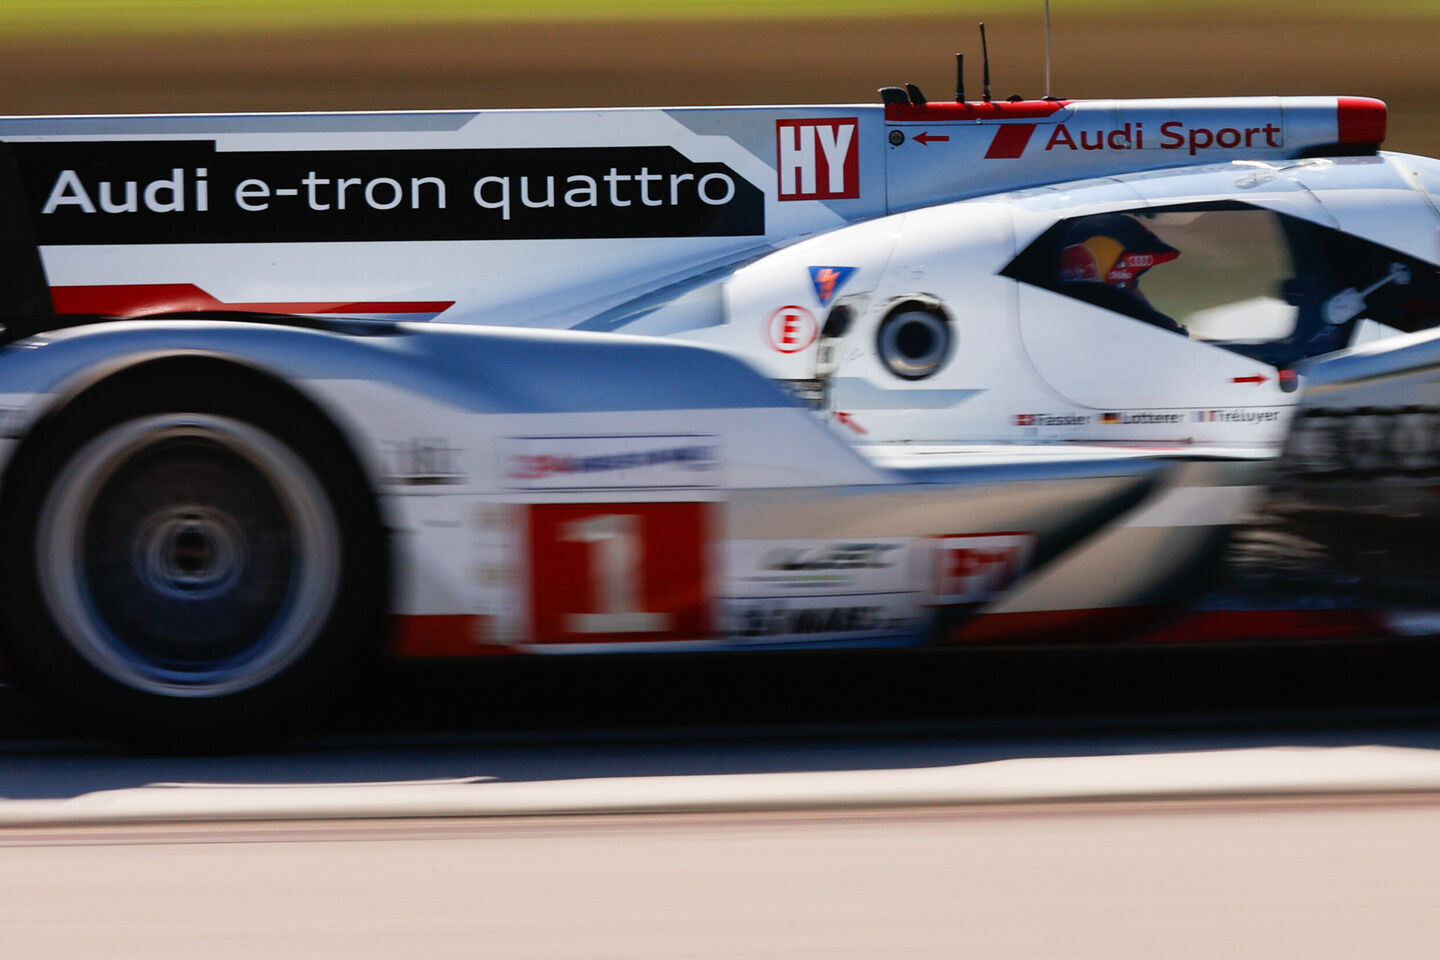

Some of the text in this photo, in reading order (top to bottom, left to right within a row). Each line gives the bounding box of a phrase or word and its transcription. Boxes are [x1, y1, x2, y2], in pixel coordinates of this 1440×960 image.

[780, 124, 855, 194] HY
[1045, 121, 1281, 155] Audi Sport
[42, 166, 736, 219] Audi e-tron quattro
[779, 315, 801, 344] E
[1122, 411, 1185, 424] Lotterer
[560, 513, 672, 633] 1
